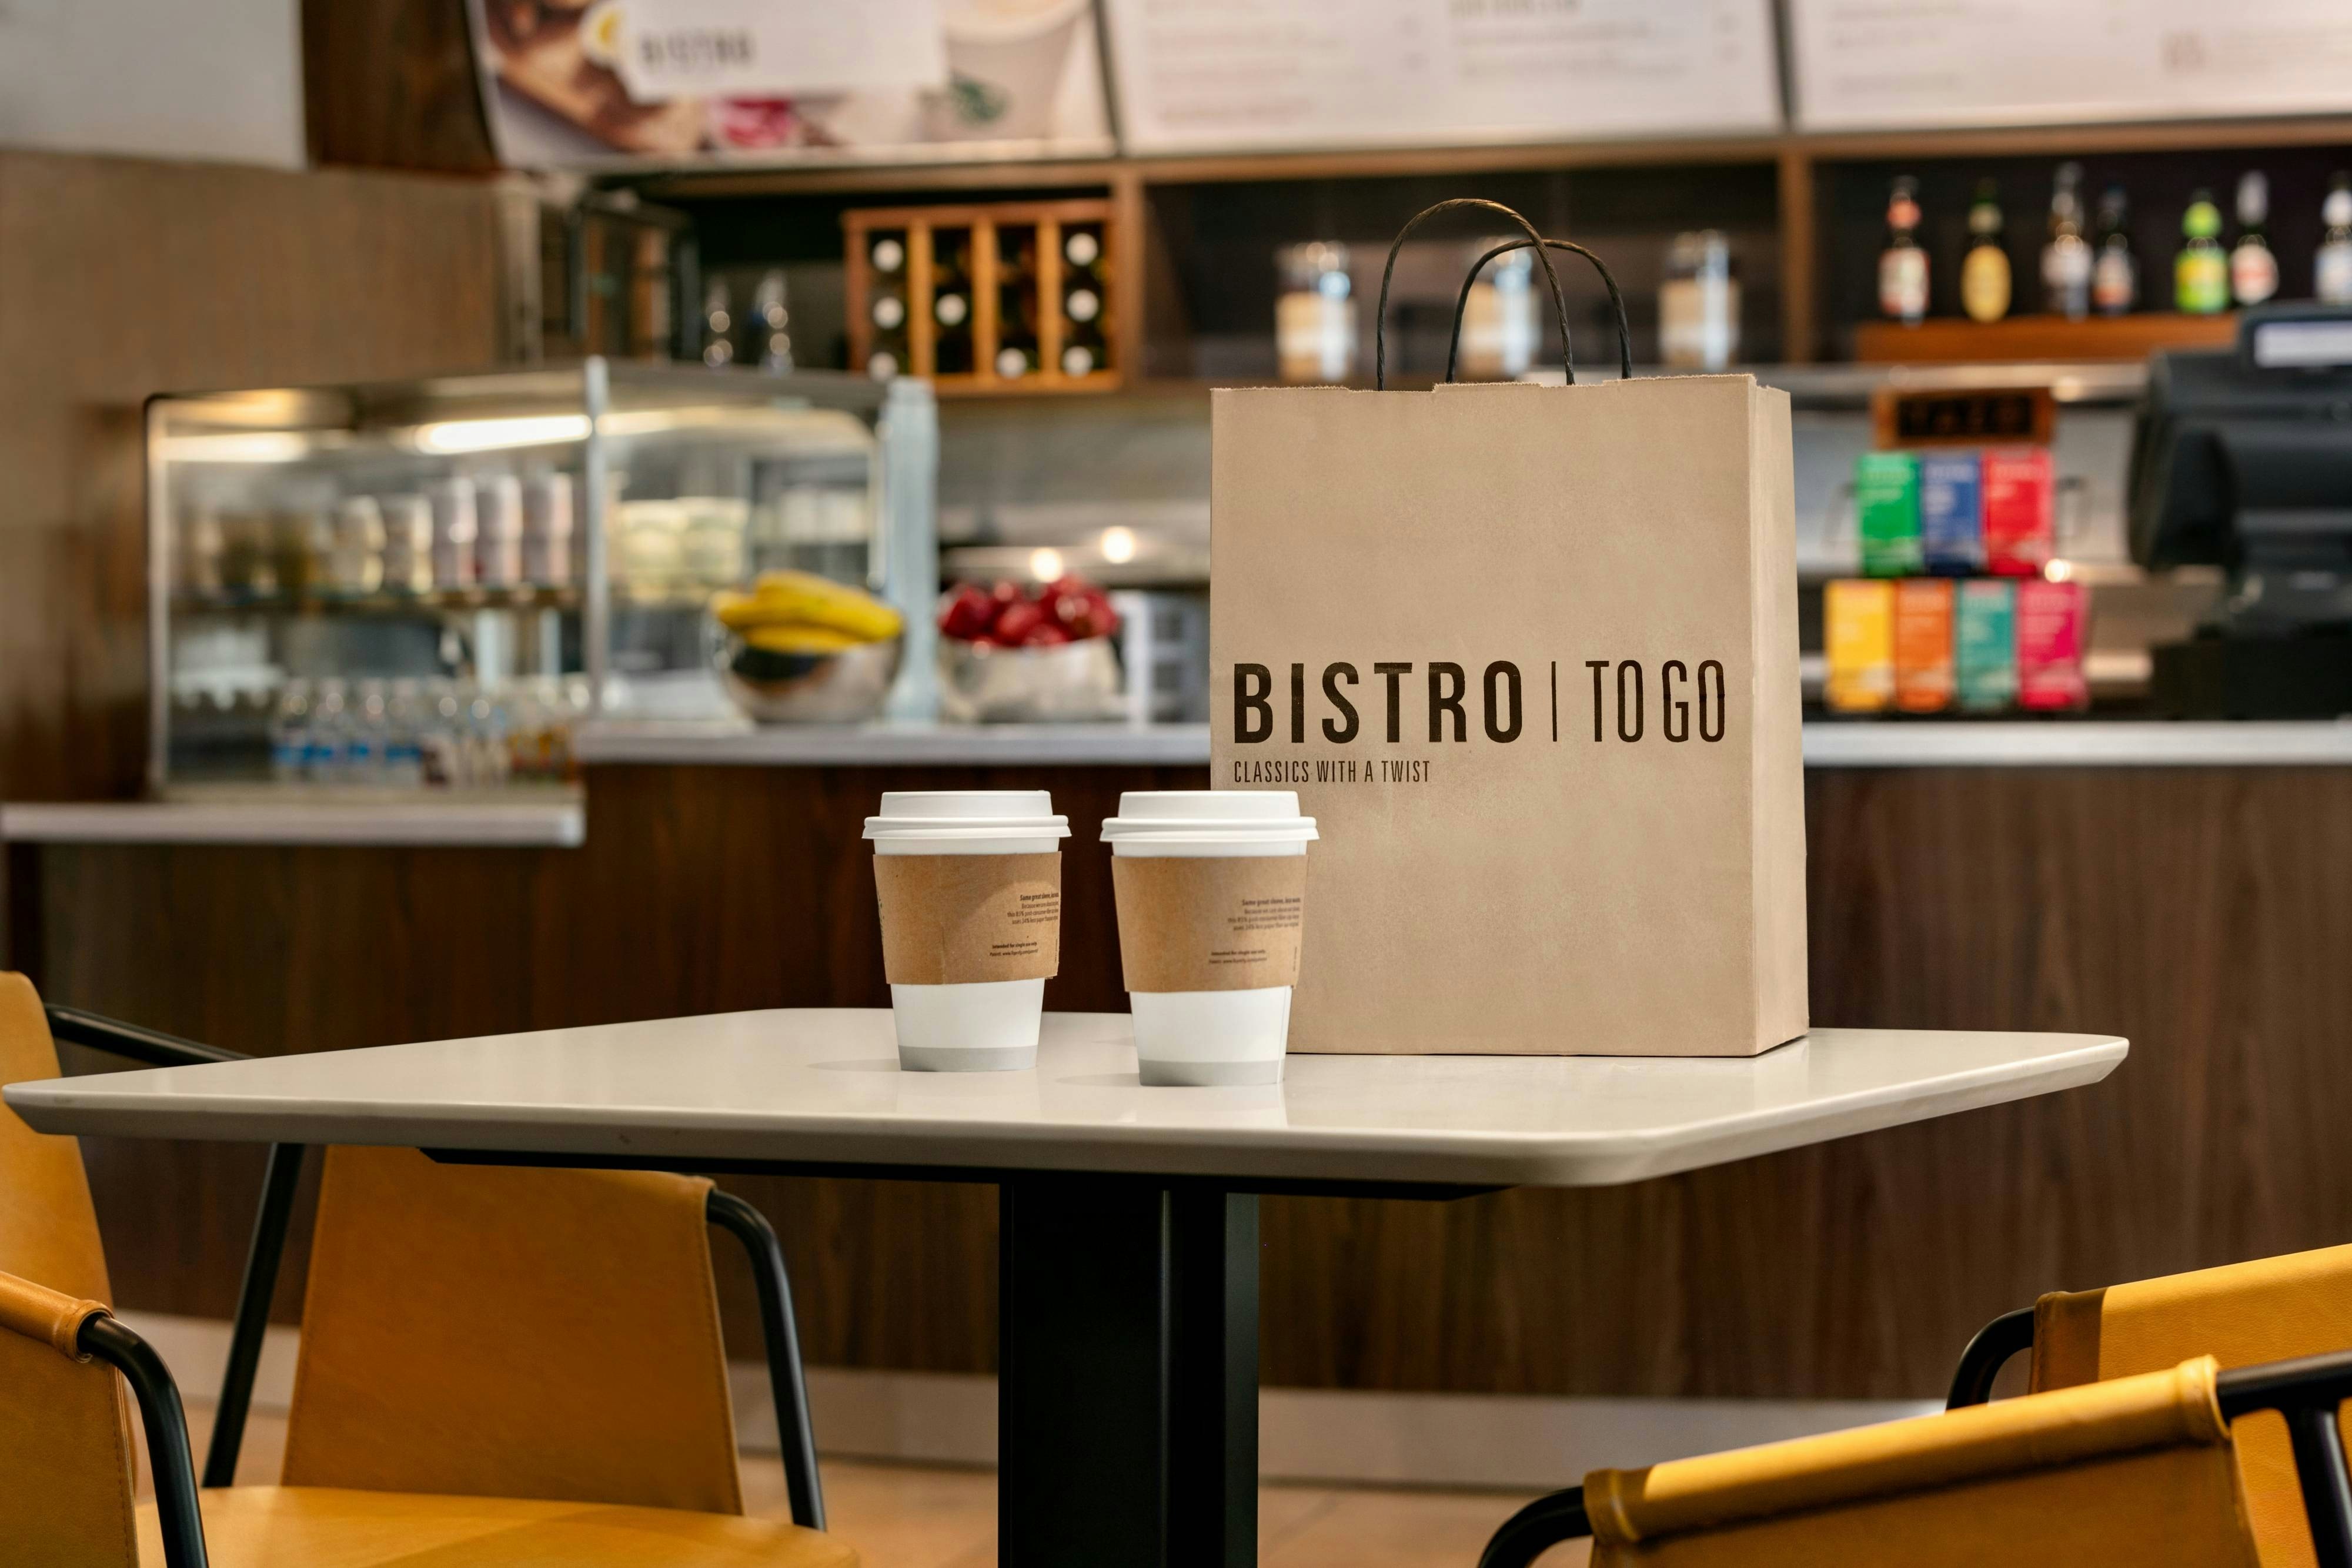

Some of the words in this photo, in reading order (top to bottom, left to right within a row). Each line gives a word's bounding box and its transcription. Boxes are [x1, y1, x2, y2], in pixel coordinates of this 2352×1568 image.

[1234, 660, 1523, 744] BISTRO
[1585, 660, 1644, 743] TO
[1662, 660, 1726, 743] GO
[1234, 760, 1309, 784] CLASSICS
[1316, 760, 1357, 783] WITH
[1364, 760, 1374, 783] A
[1381, 760, 1431, 783] TWIST
[1032, 893, 1041, 901] great
